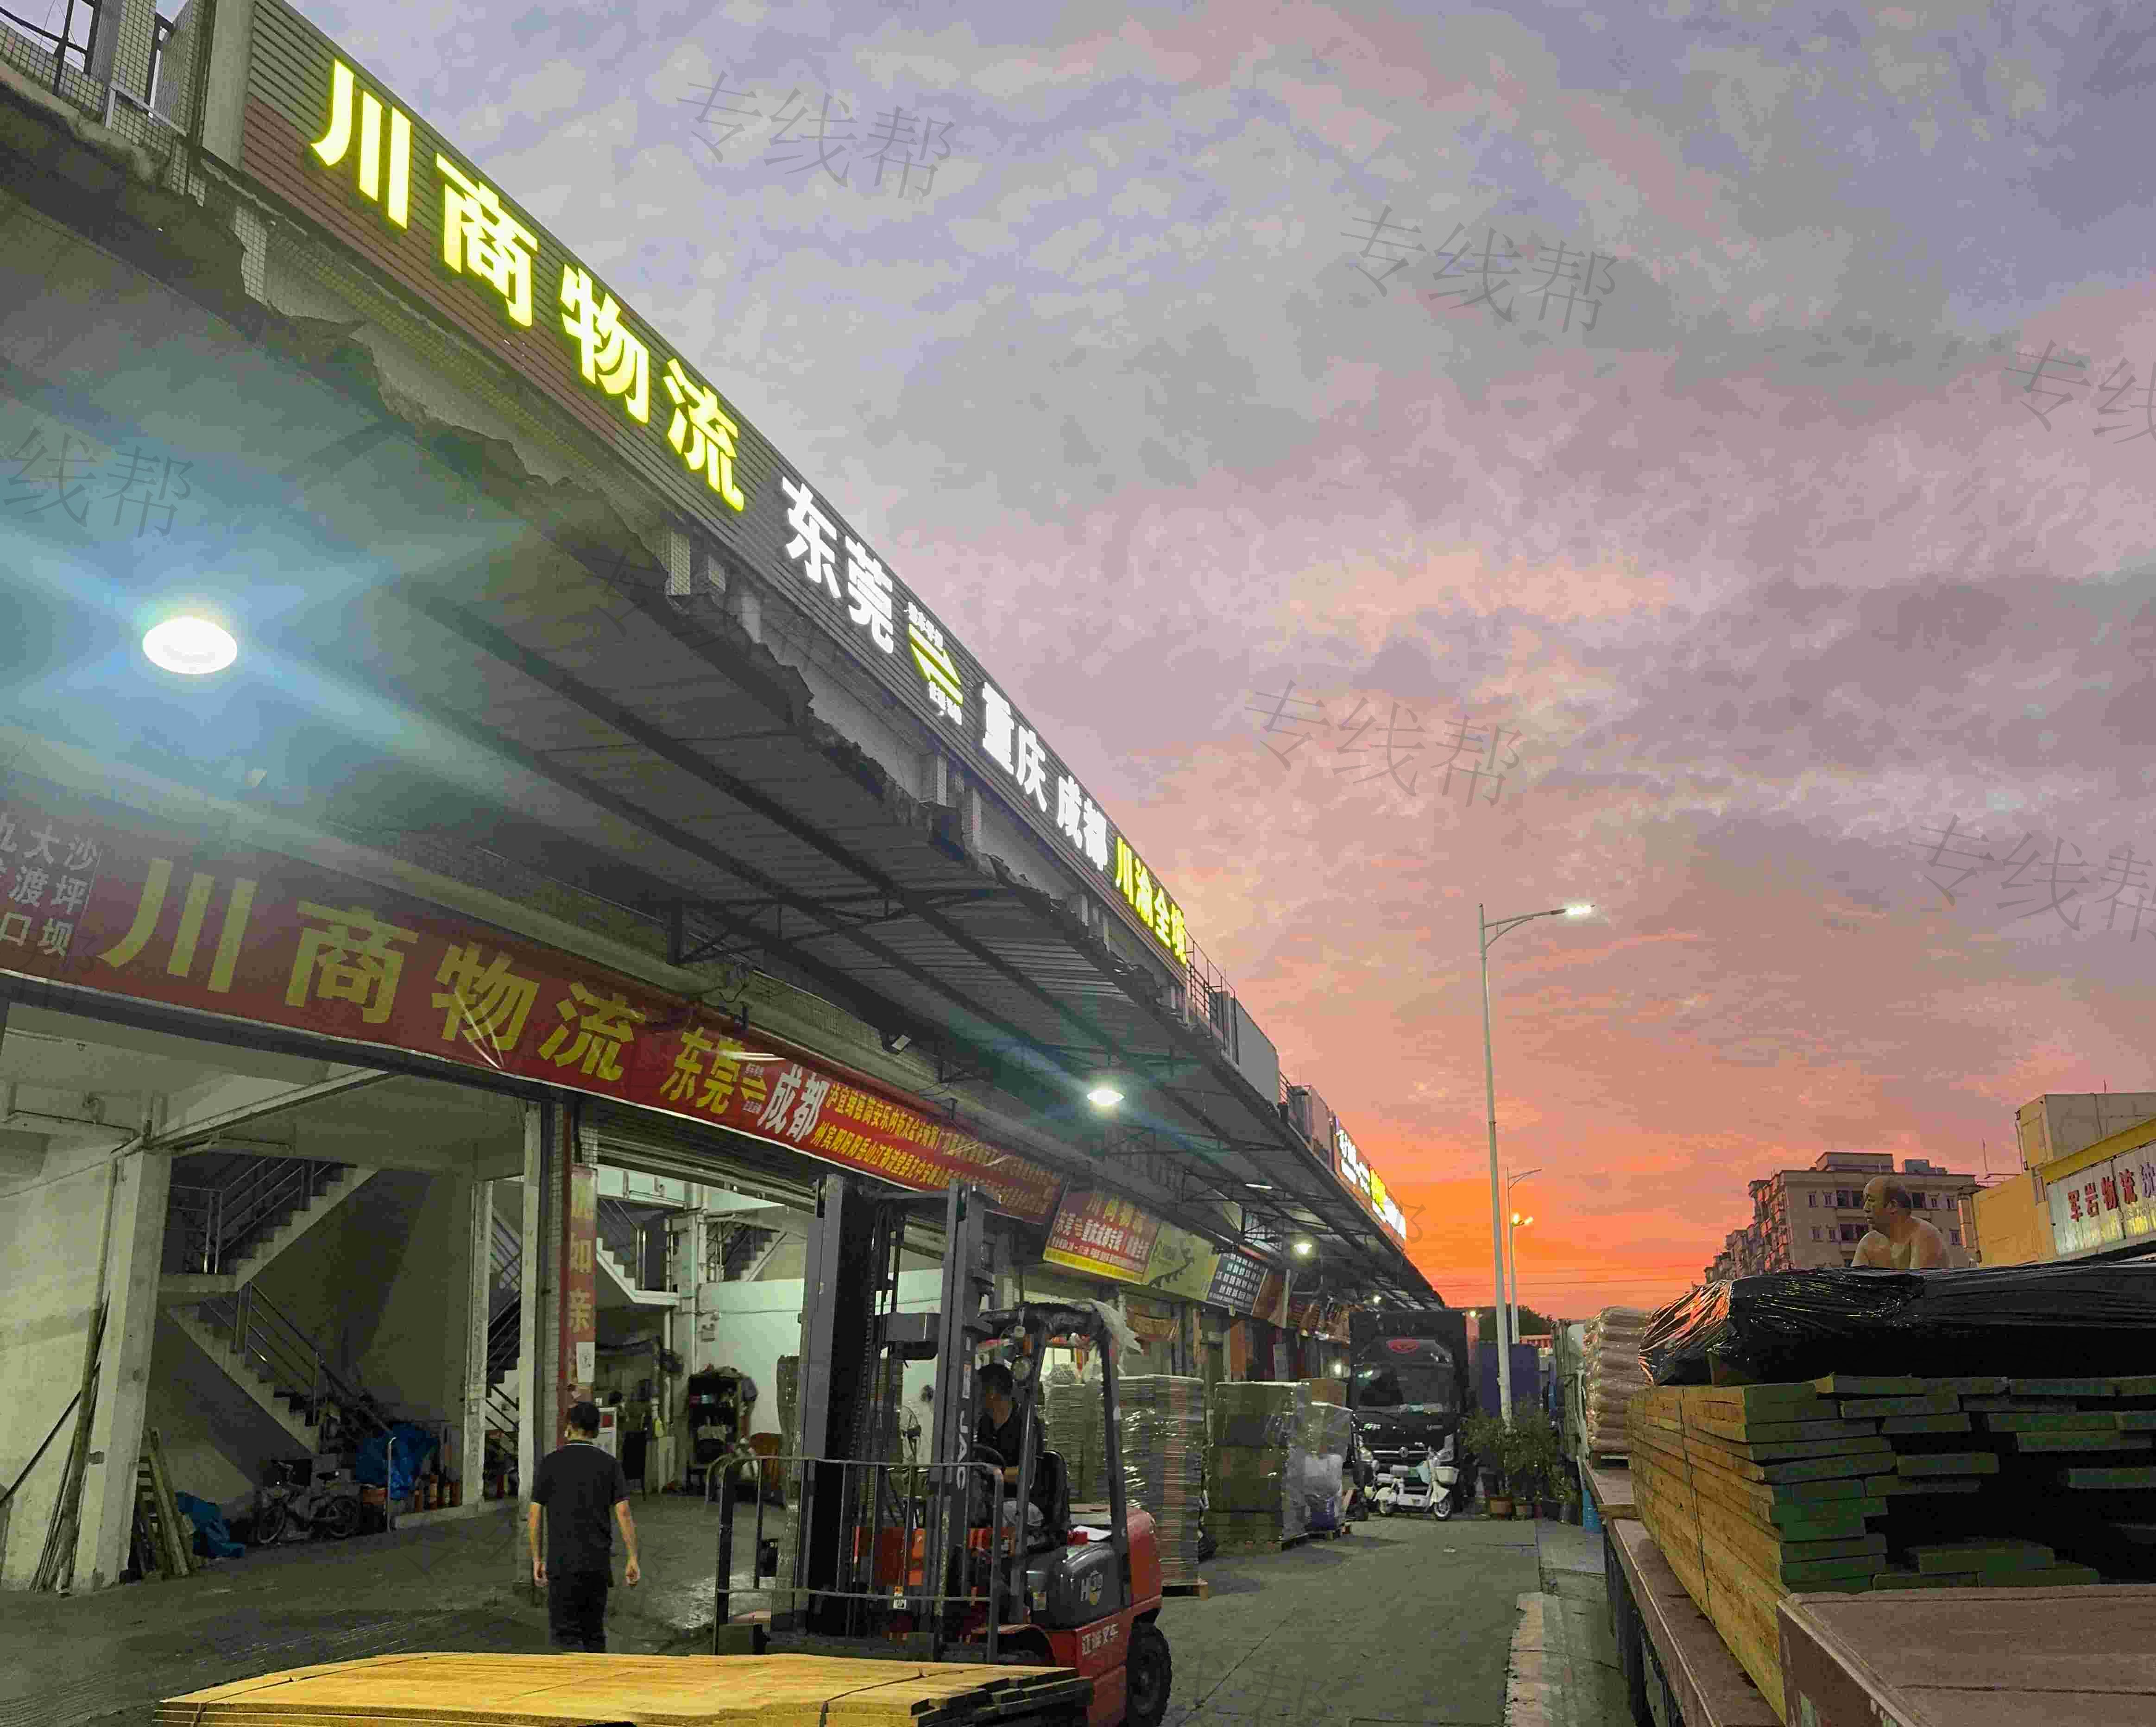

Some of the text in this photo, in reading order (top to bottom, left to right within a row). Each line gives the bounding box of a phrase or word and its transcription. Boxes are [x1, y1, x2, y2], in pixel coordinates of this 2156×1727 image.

[311, 60, 744, 511] 川商物流
[782, 477, 894, 653] 东莞
[983, 682, 1047, 811] 重庆
[1057, 775, 1108, 871] 成都
[97, 857, 647, 1081] 川商物流
[659, 1027, 747, 1114] 东莞
[757, 1064, 830, 1142] 成都
[957, 1410, 968, 1490] JAC
